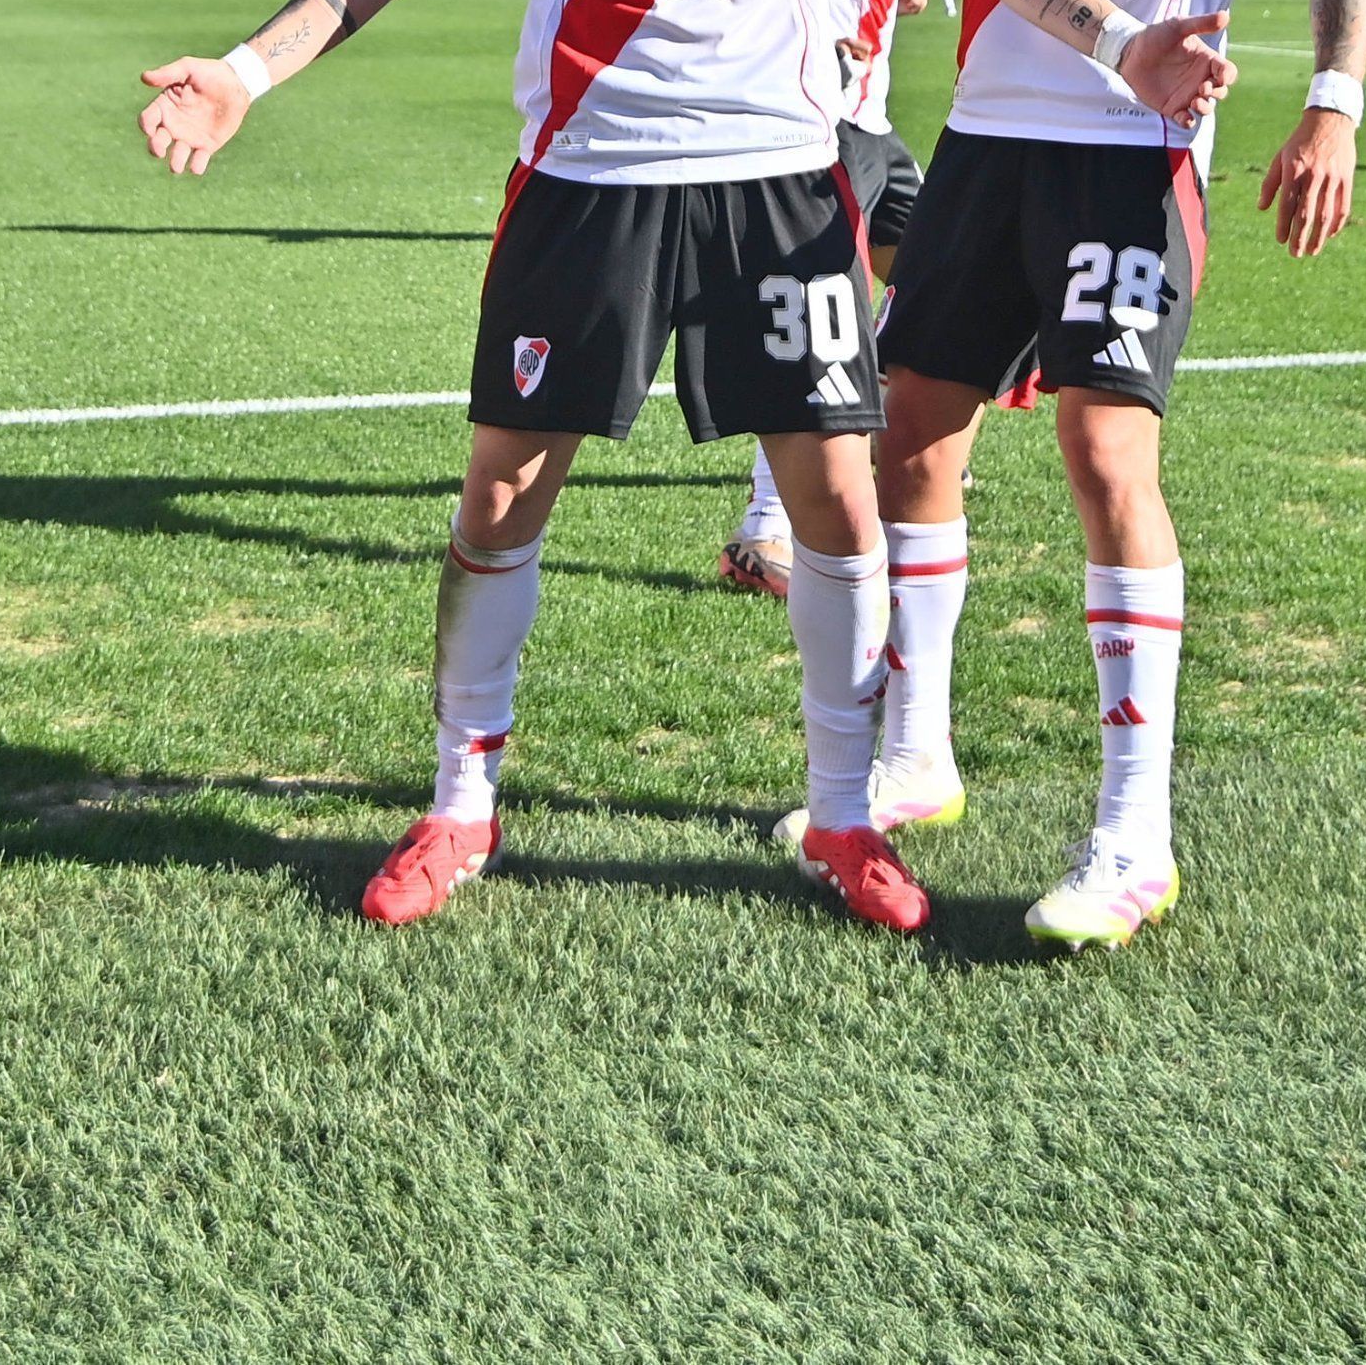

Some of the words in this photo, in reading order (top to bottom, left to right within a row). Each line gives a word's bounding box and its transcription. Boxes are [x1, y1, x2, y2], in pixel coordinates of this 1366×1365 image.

[1071, 5, 1093, 28] 30
[758, 273, 860, 364] 30
[1061, 241, 1166, 332] 28
